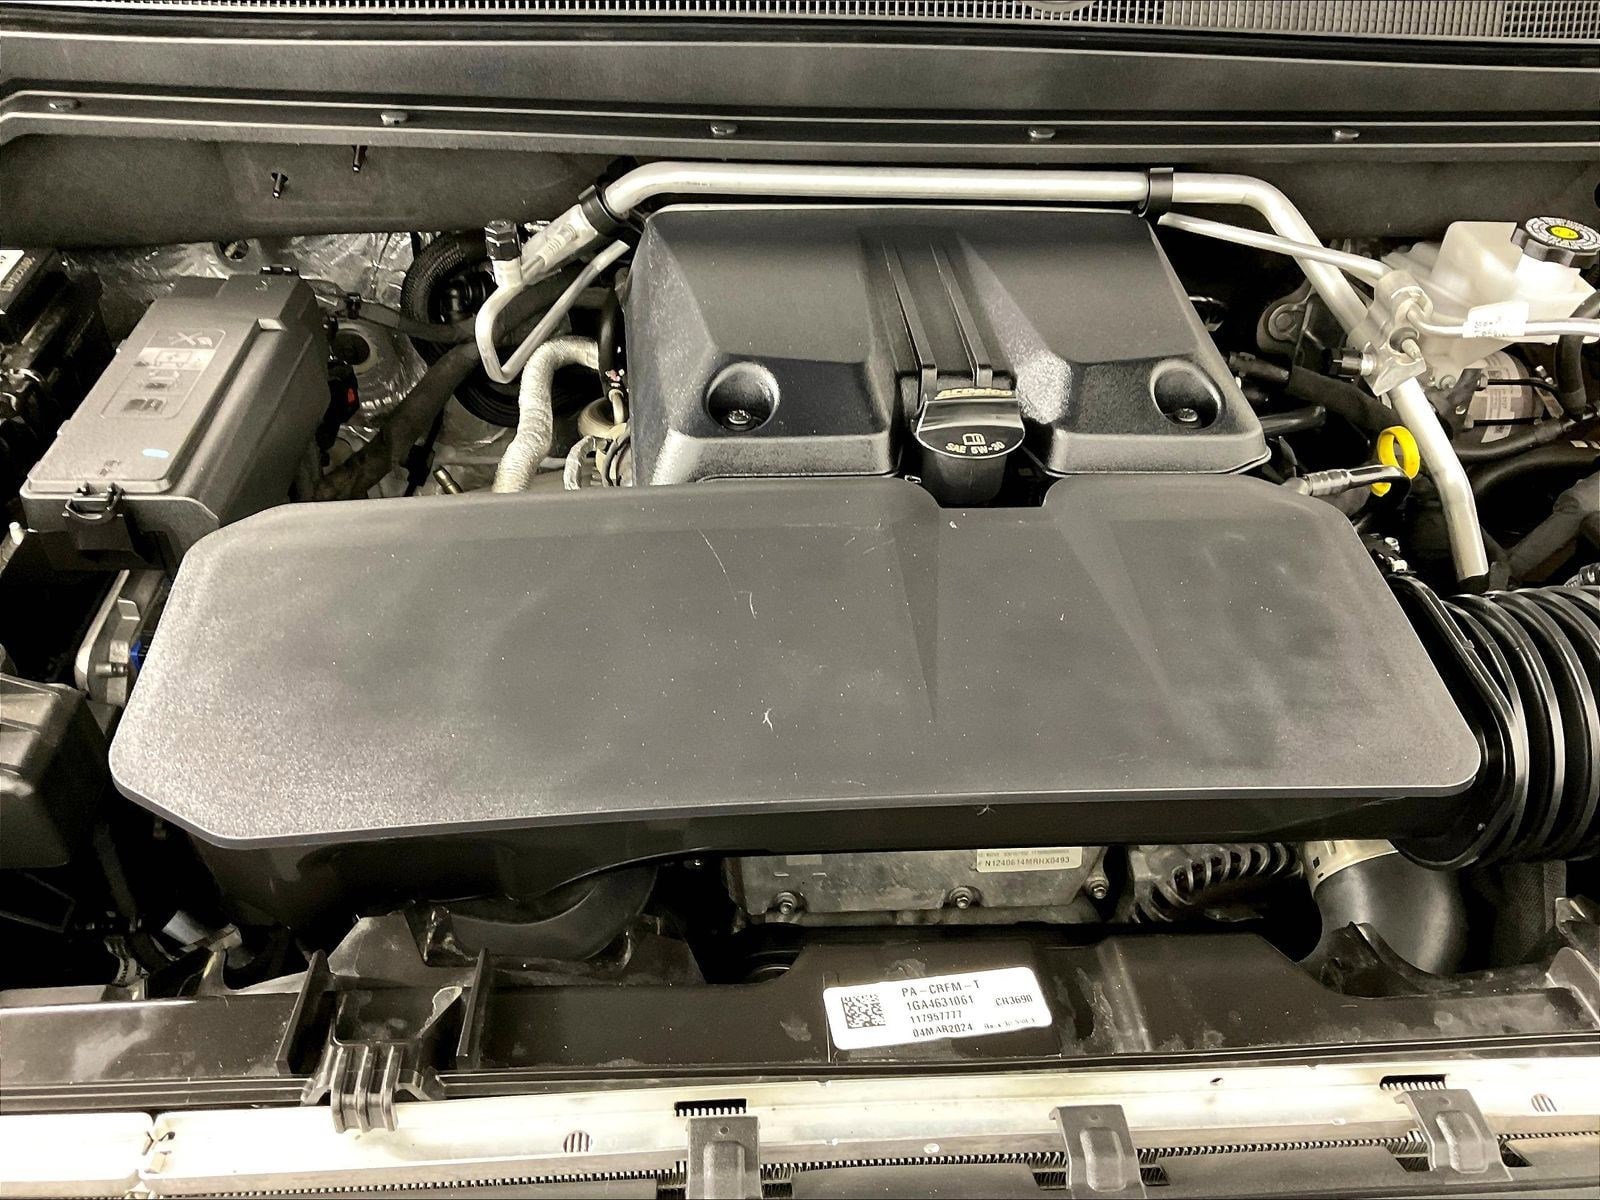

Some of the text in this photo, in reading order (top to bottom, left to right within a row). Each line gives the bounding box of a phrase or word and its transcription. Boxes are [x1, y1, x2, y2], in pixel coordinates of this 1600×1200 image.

[945, 441, 1005, 454] SAE 5W-30
[912, 1023, 974, 1038] 04MAR2024
